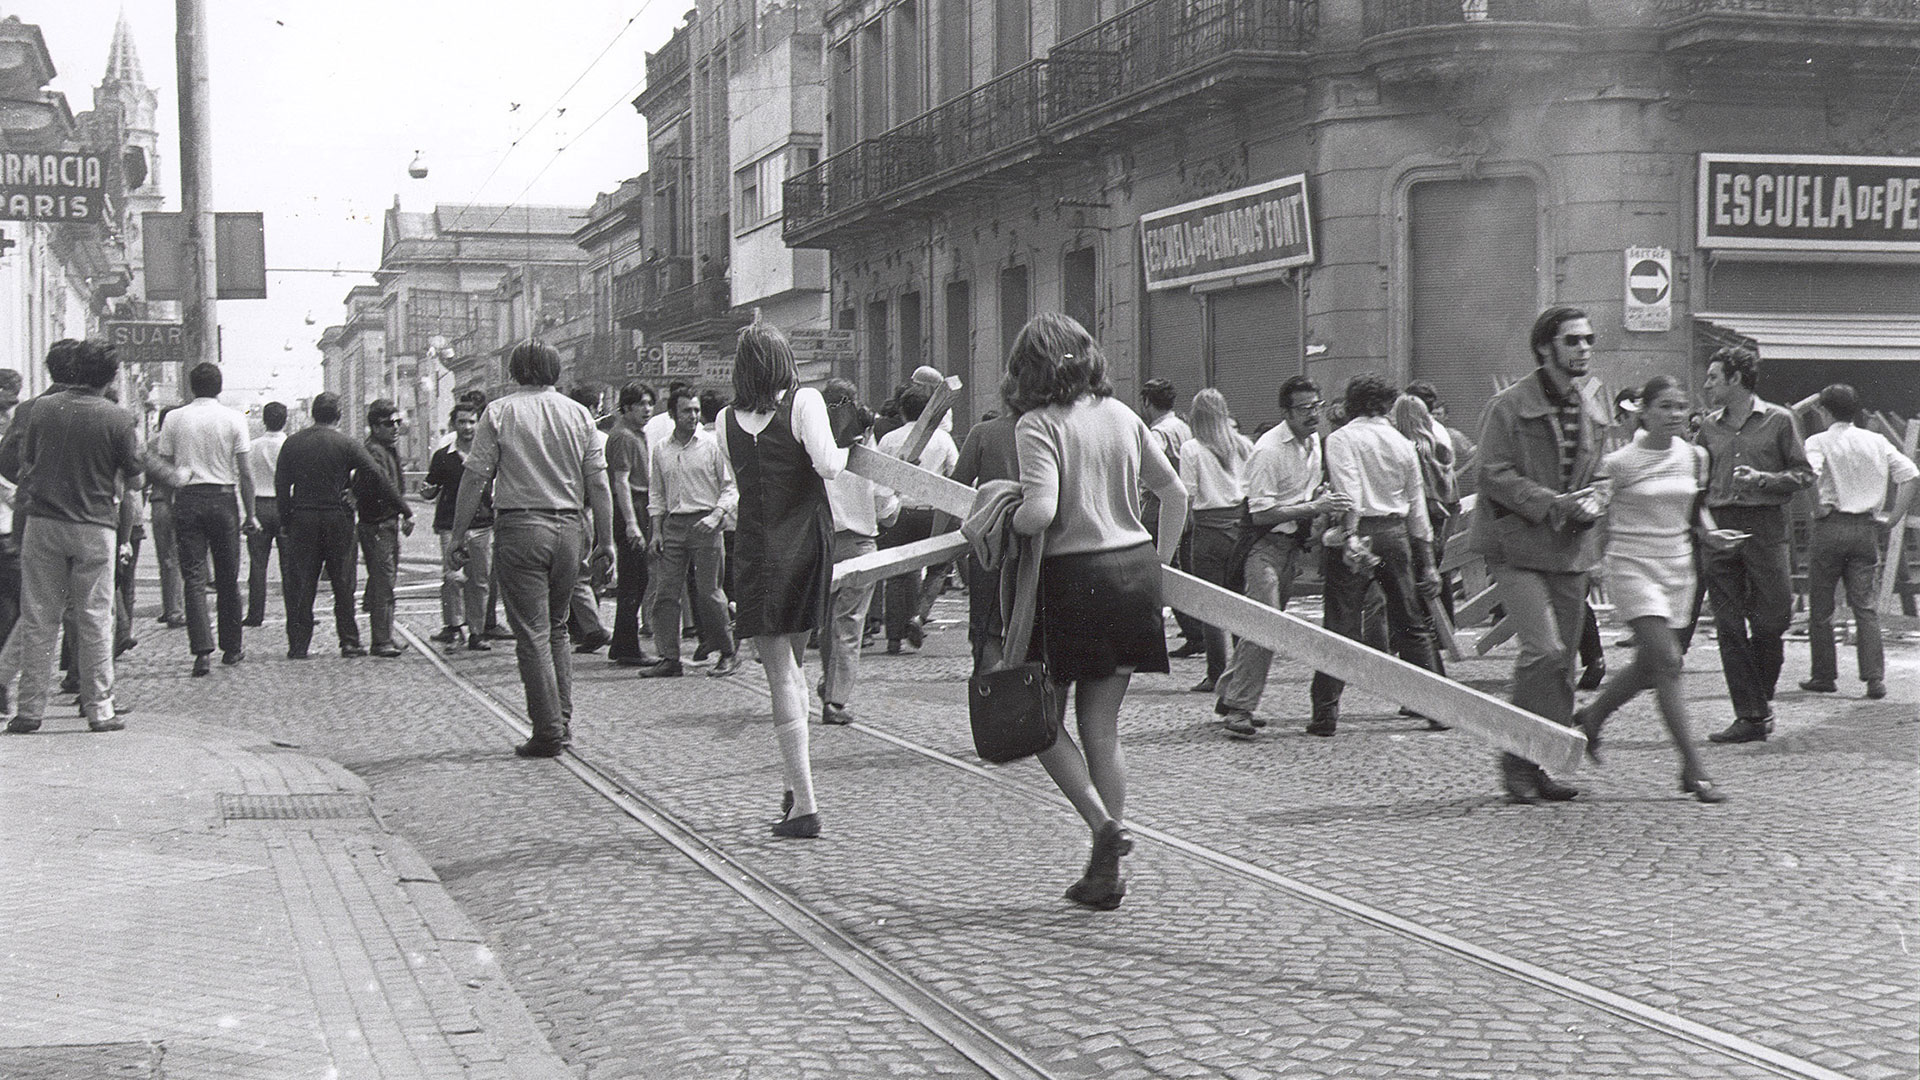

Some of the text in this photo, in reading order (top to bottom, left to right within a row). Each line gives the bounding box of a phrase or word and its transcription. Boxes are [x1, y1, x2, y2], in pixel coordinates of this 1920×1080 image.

[0, 153, 101, 188] RMACIA
[1715, 173, 1920, 229] ESCUELA DE PE
[1147, 221, 1196, 272] ESCUELA
